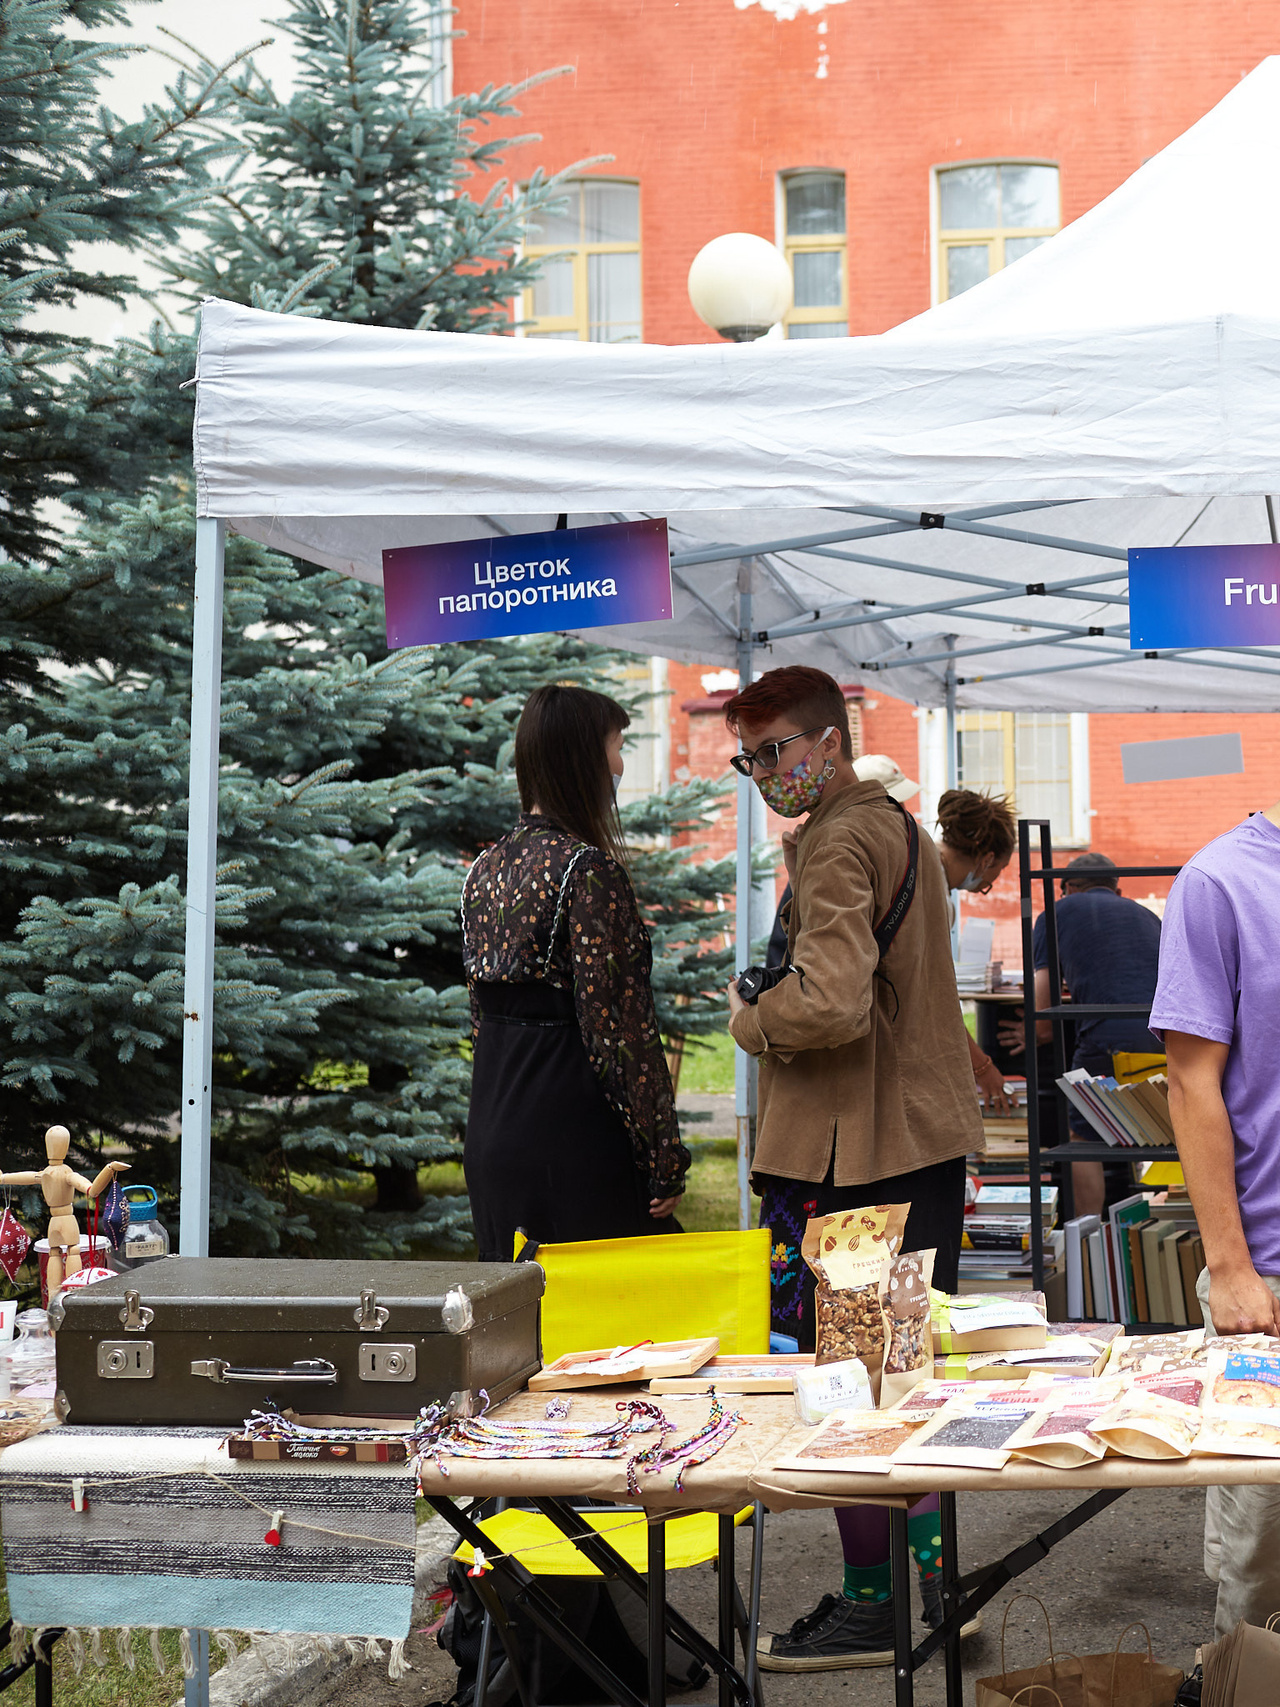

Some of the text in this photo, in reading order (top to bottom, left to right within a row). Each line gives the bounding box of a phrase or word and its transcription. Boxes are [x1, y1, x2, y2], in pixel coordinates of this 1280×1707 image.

[473, 557, 572, 588] Цветок
[438, 577, 618, 614] папоротника
[884, 868, 915, 931] EOS DIGITAL
